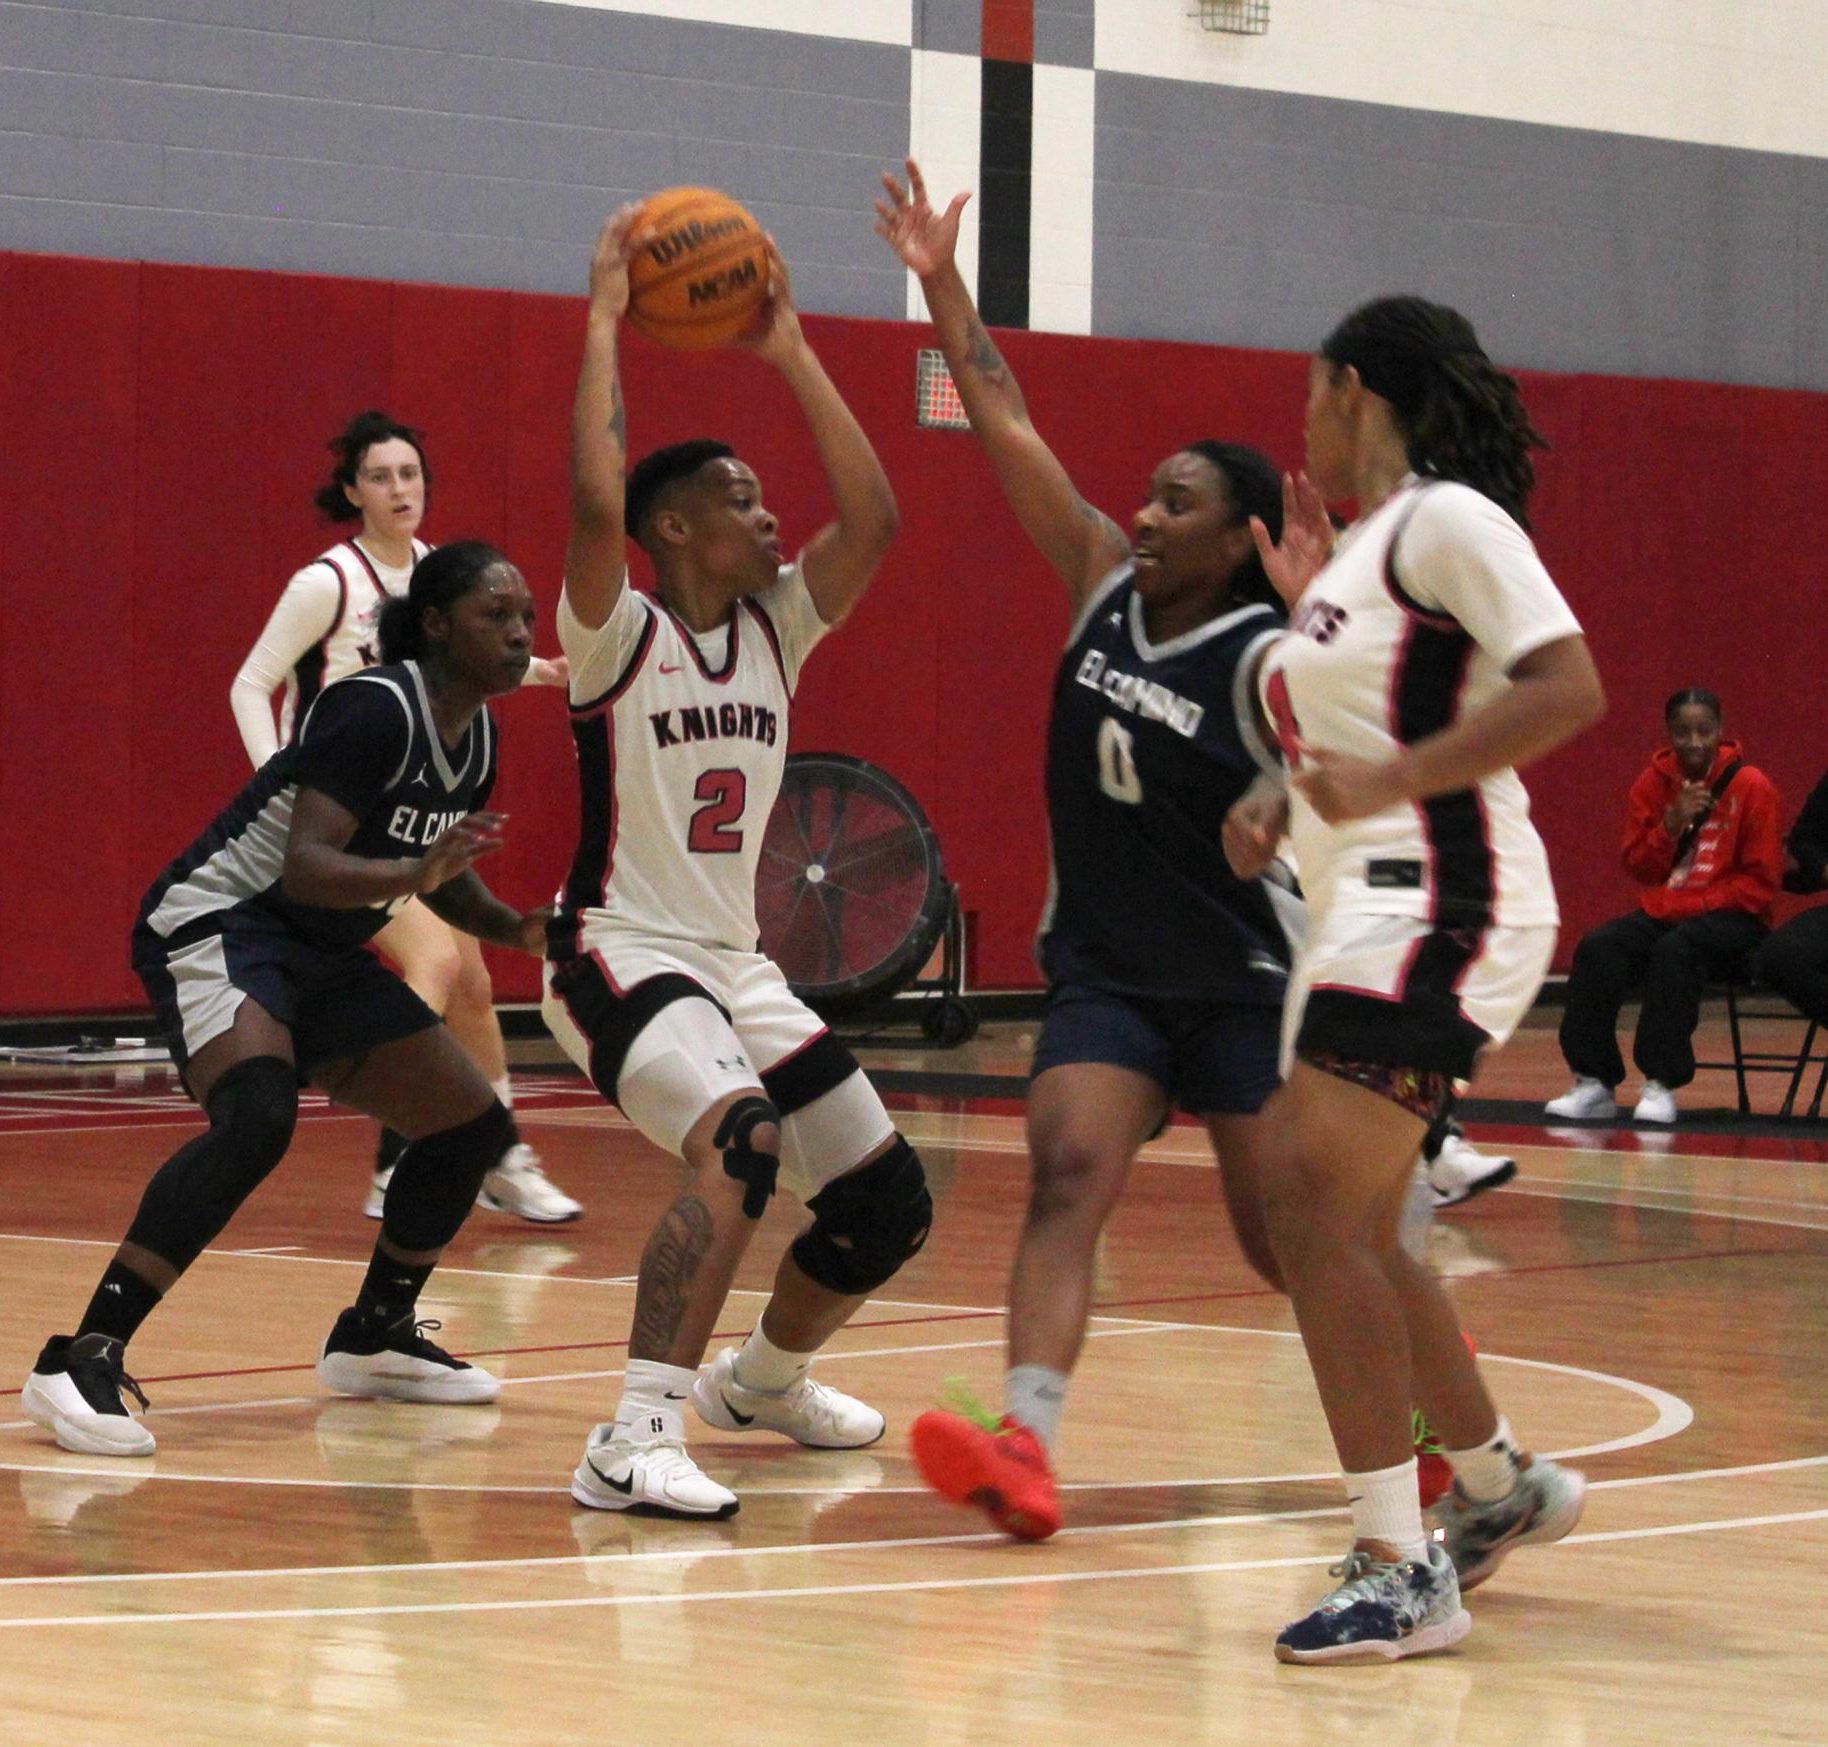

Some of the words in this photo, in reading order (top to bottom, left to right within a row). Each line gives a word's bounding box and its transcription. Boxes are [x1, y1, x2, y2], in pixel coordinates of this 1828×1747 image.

[648, 702, 777, 750] KNIGHTS
[1097, 715, 1144, 804] 0
[387, 804, 419, 845] EL
[687, 767, 746, 853] 2
